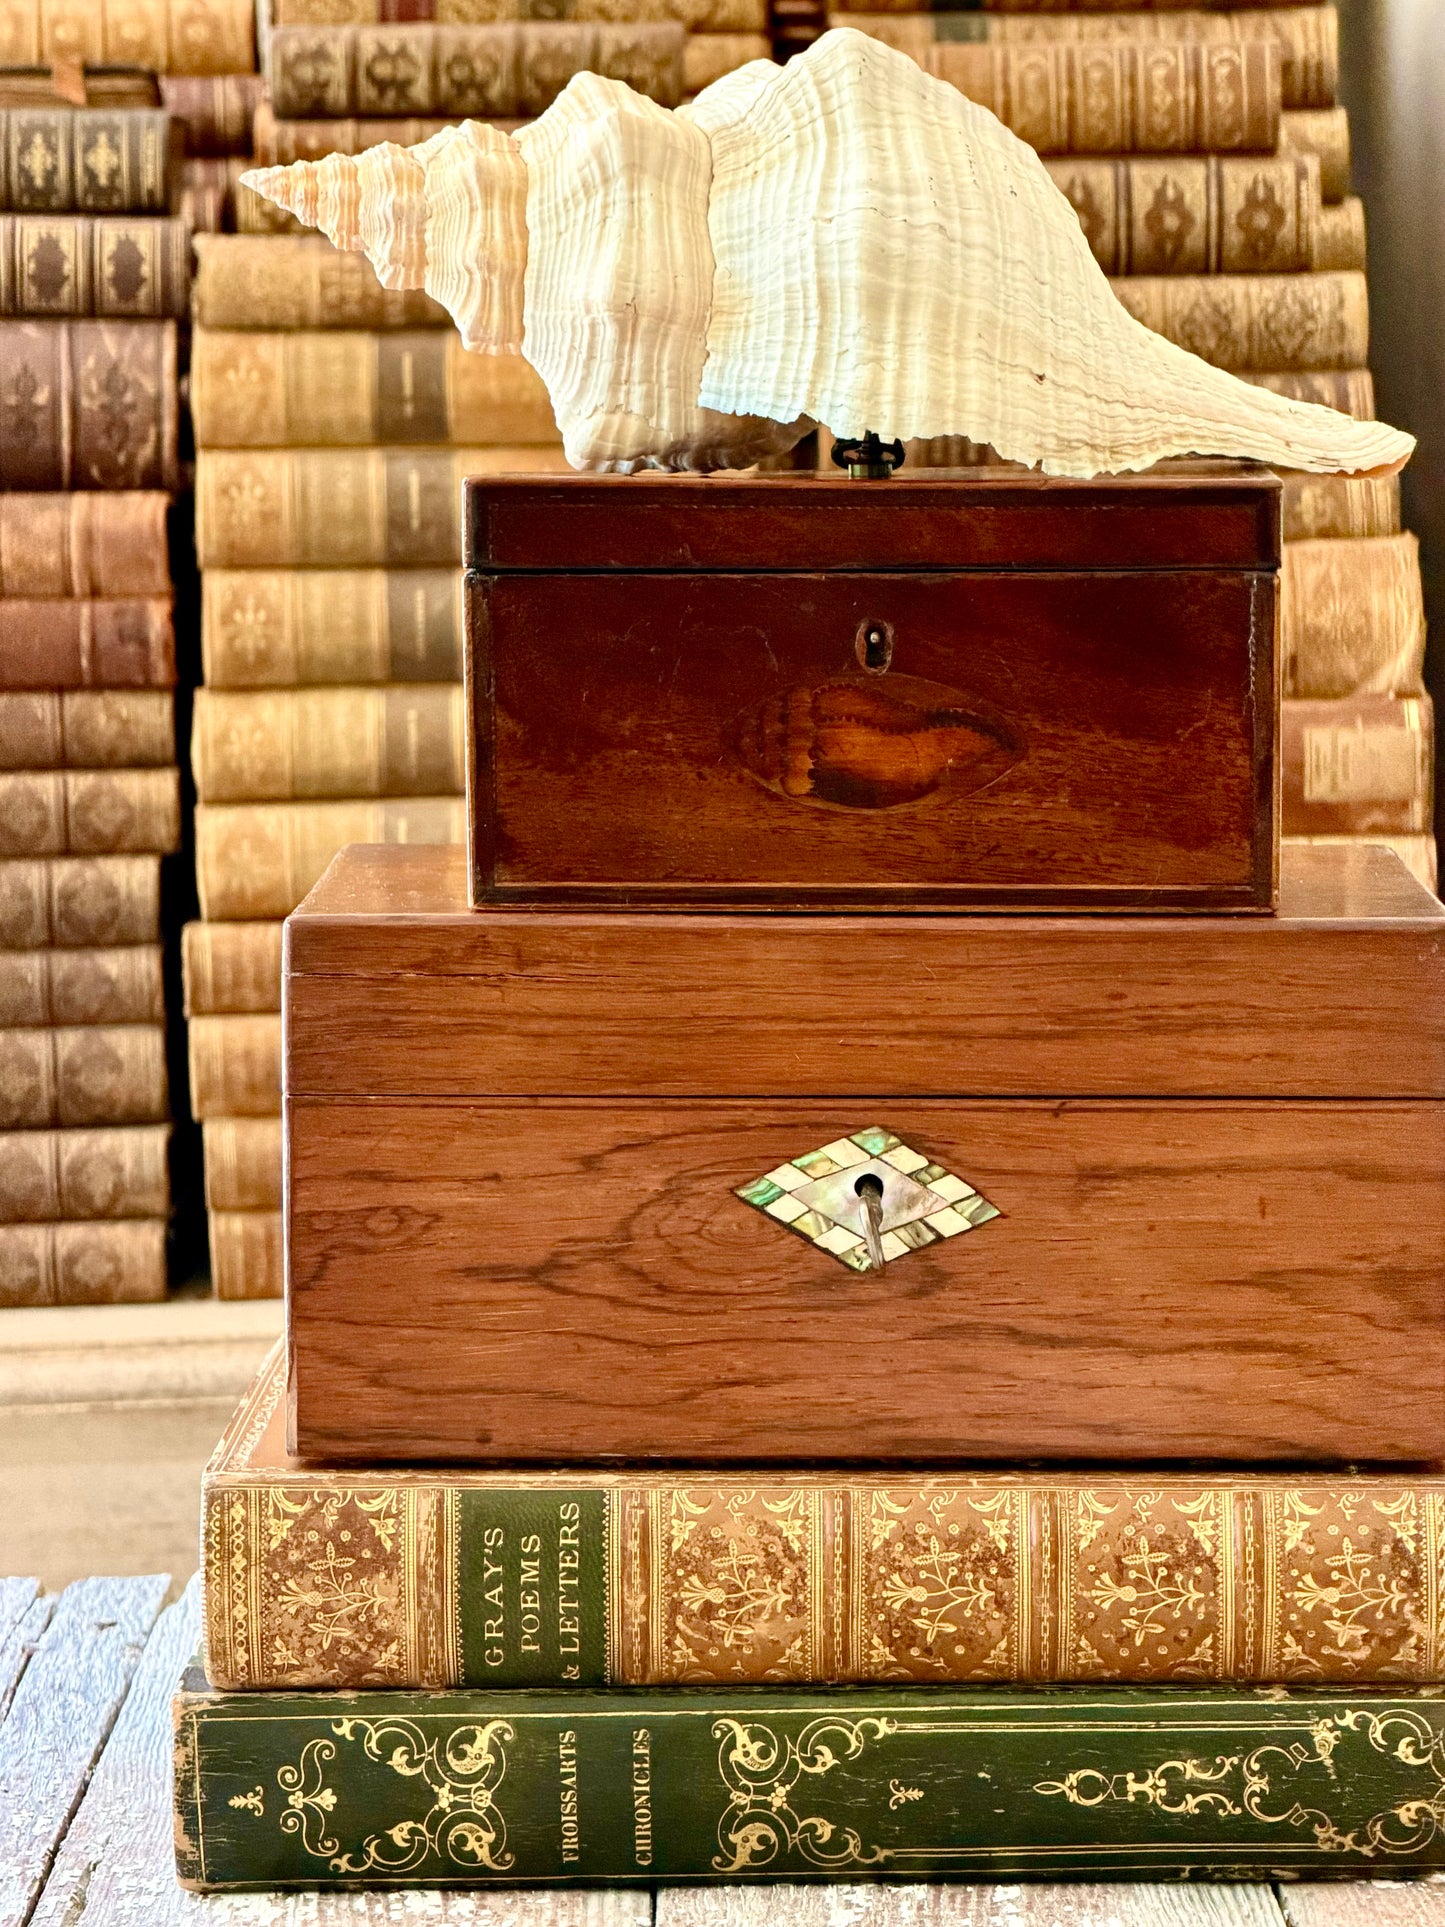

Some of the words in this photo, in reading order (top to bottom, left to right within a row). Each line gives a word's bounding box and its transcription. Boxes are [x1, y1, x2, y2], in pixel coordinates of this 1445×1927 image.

[484, 1527, 504, 1667] GRAY'S
[521, 1534, 541, 1654] POEMS
[559, 1502, 580, 1653] LETTERS
[561, 1663, 580, 1680] &
[559, 1730, 579, 1864] FROISSARTS
[633, 1728, 653, 1866] CHRONICLES
